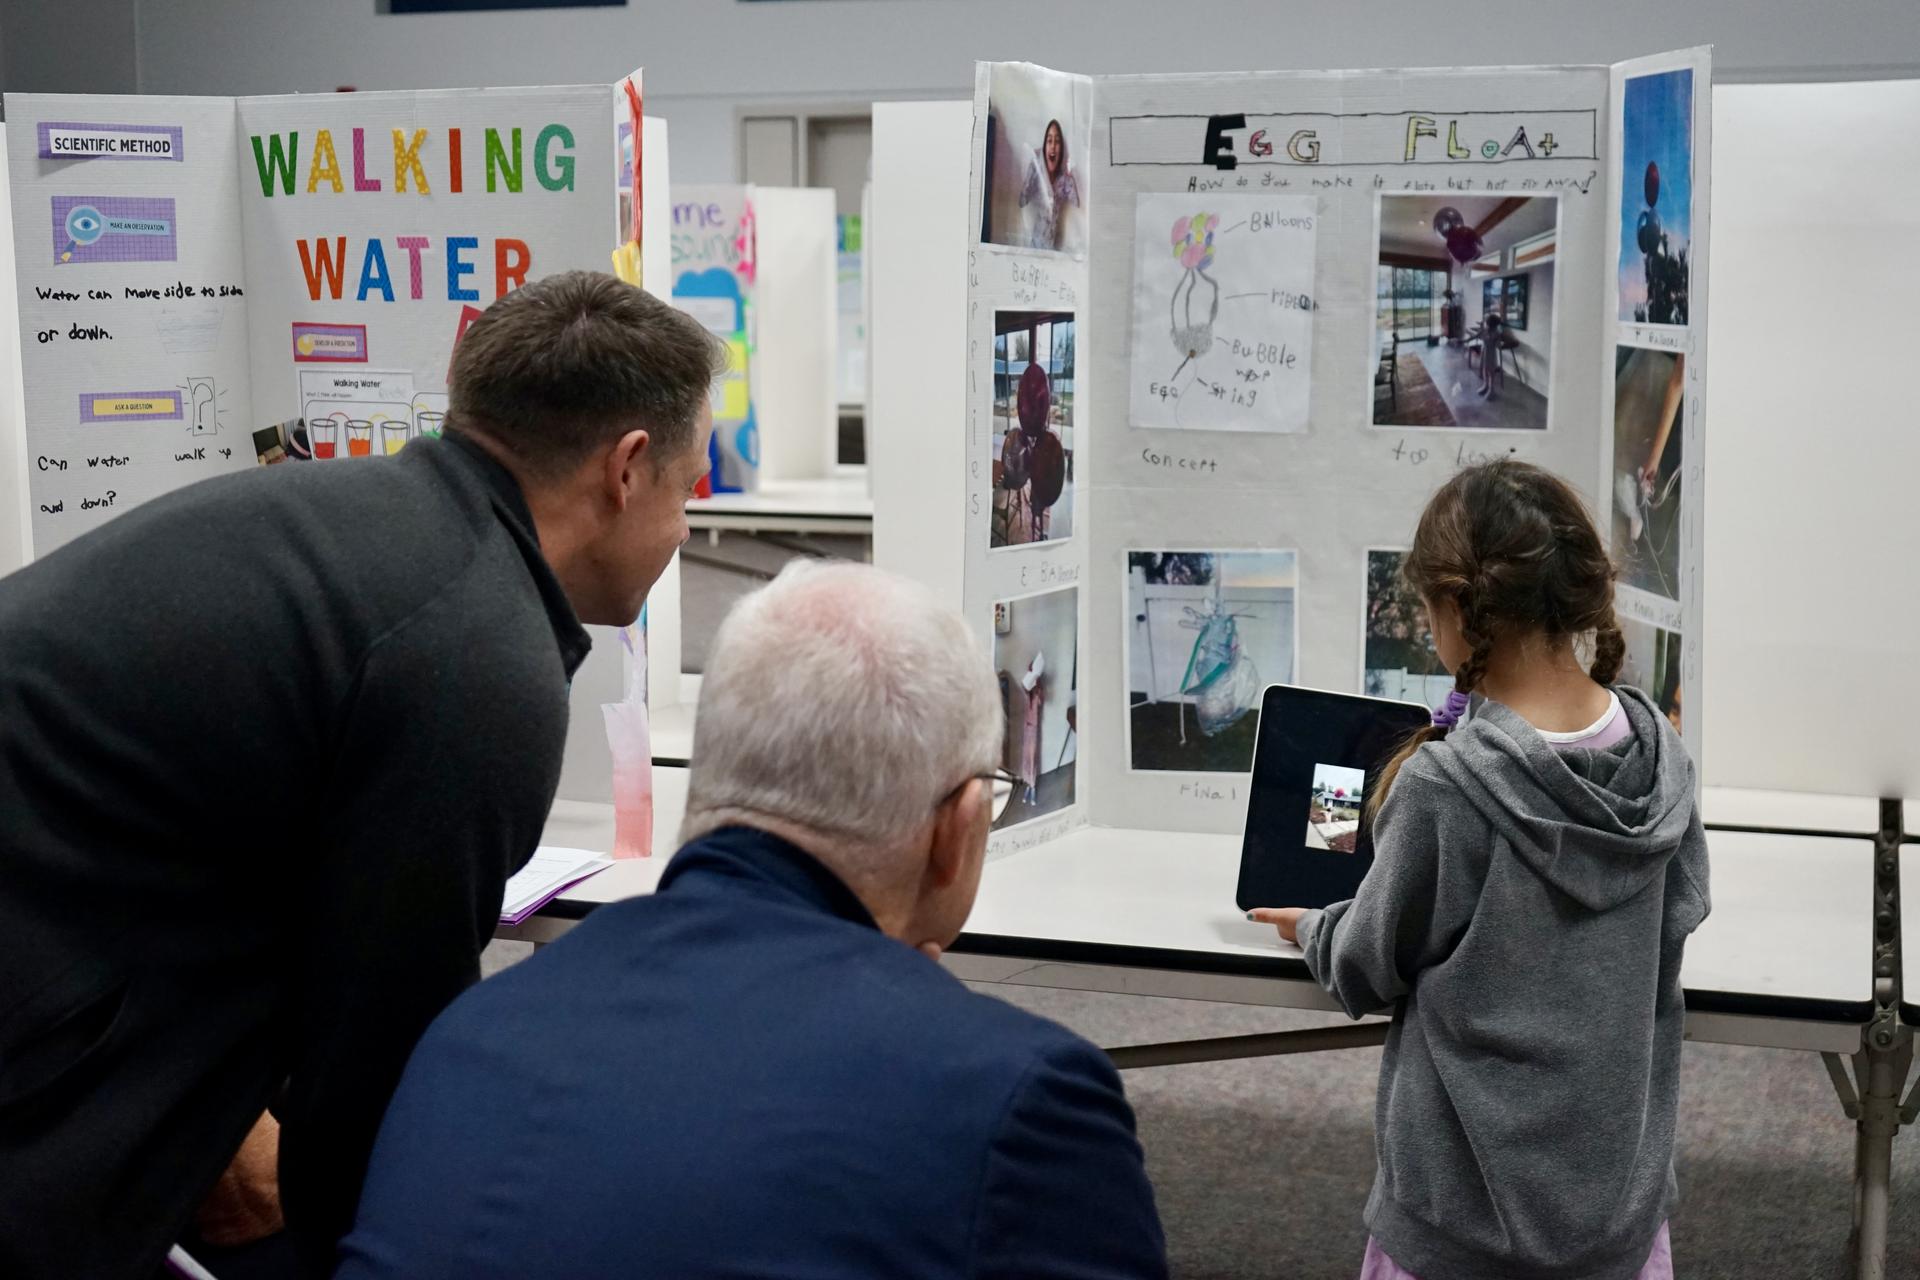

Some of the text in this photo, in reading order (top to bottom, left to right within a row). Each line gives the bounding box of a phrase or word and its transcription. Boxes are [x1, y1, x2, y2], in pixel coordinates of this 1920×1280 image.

[54, 137, 171, 154] SCIENTIFIC METHOD
[1202, 114, 1320, 170] EGG
[250, 122, 576, 198] WALKING
[1373, 174, 1385, 188] it
[296, 236, 533, 302] WATER
[35, 287, 80, 301] Water
[88, 289, 112, 300] can
[163, 281, 195, 299] side
[200, 287, 215, 298] to
[37, 322, 113, 343] or down.
[333, 379, 381, 389] Walking Water
[37, 456, 68, 471] Can
[40, 499, 64, 513] and
